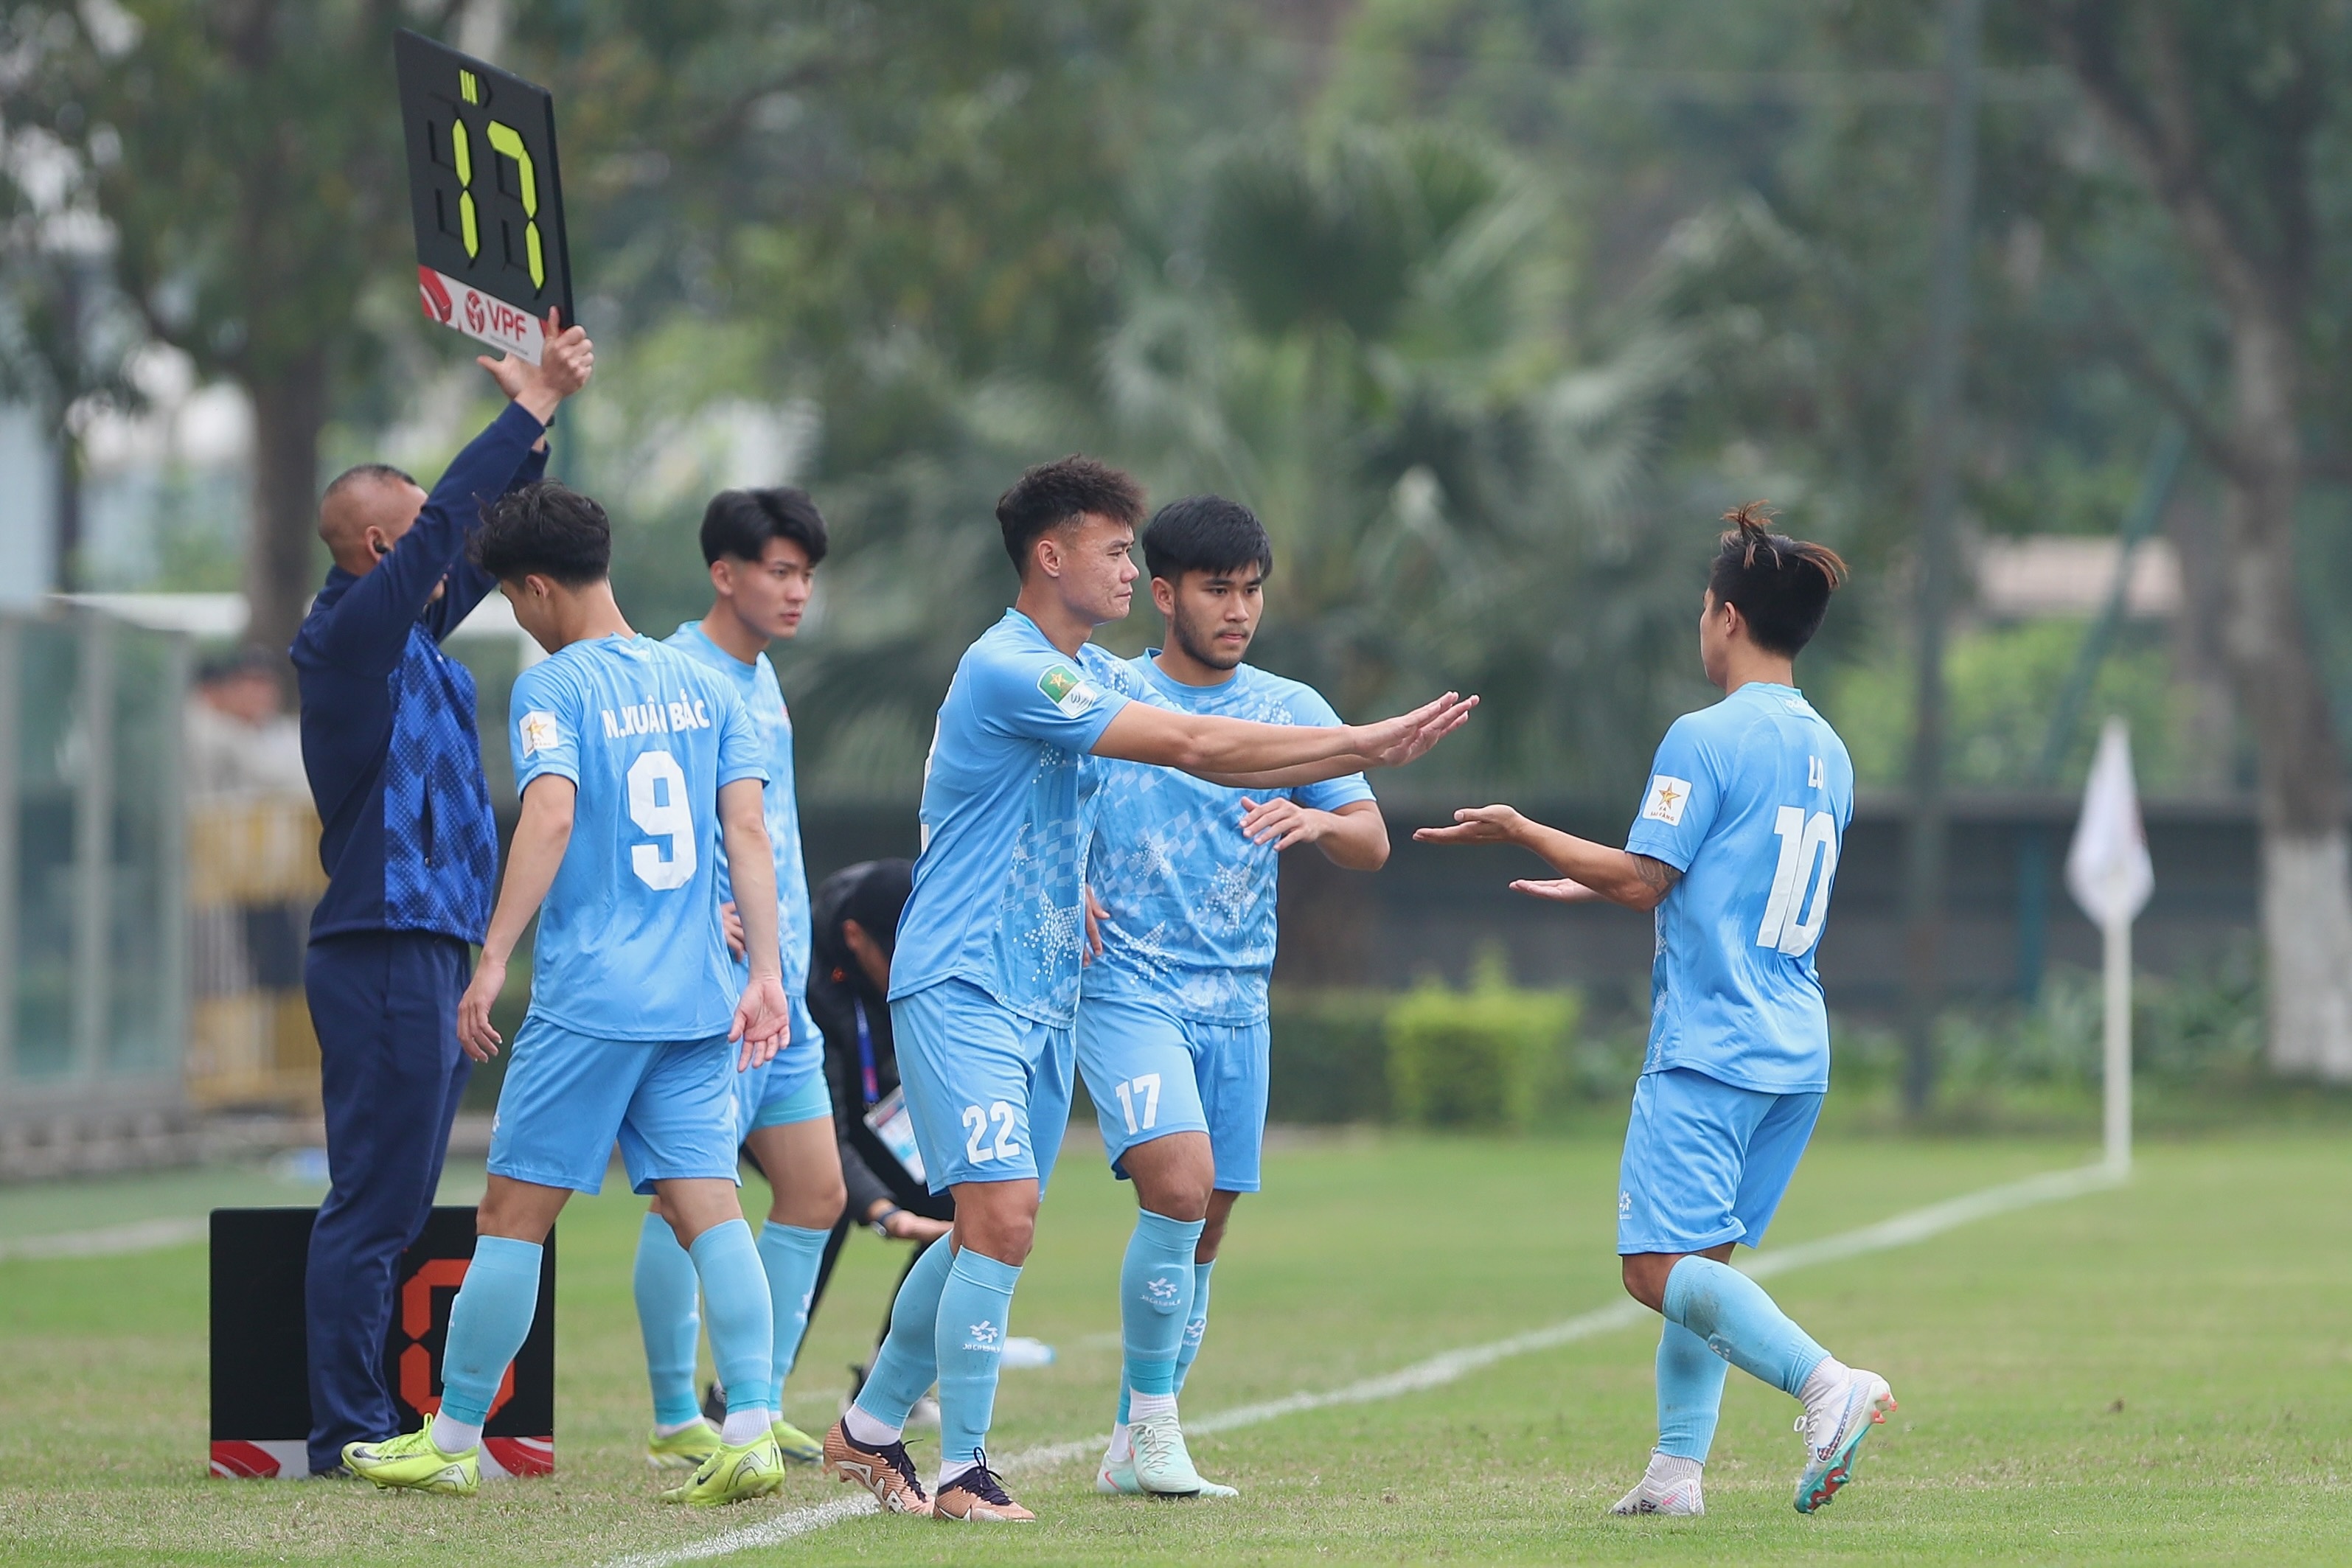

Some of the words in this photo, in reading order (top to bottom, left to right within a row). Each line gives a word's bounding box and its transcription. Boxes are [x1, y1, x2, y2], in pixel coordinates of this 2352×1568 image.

[452, 118, 545, 290] 17
[487, 299, 526, 341] VPF
[669, 688, 711, 733] BẮC
[627, 750, 697, 892] 9
[1756, 805, 1837, 958] 10
[962, 1101, 1020, 1164] 22
[1116, 1073, 1161, 1136] 17
